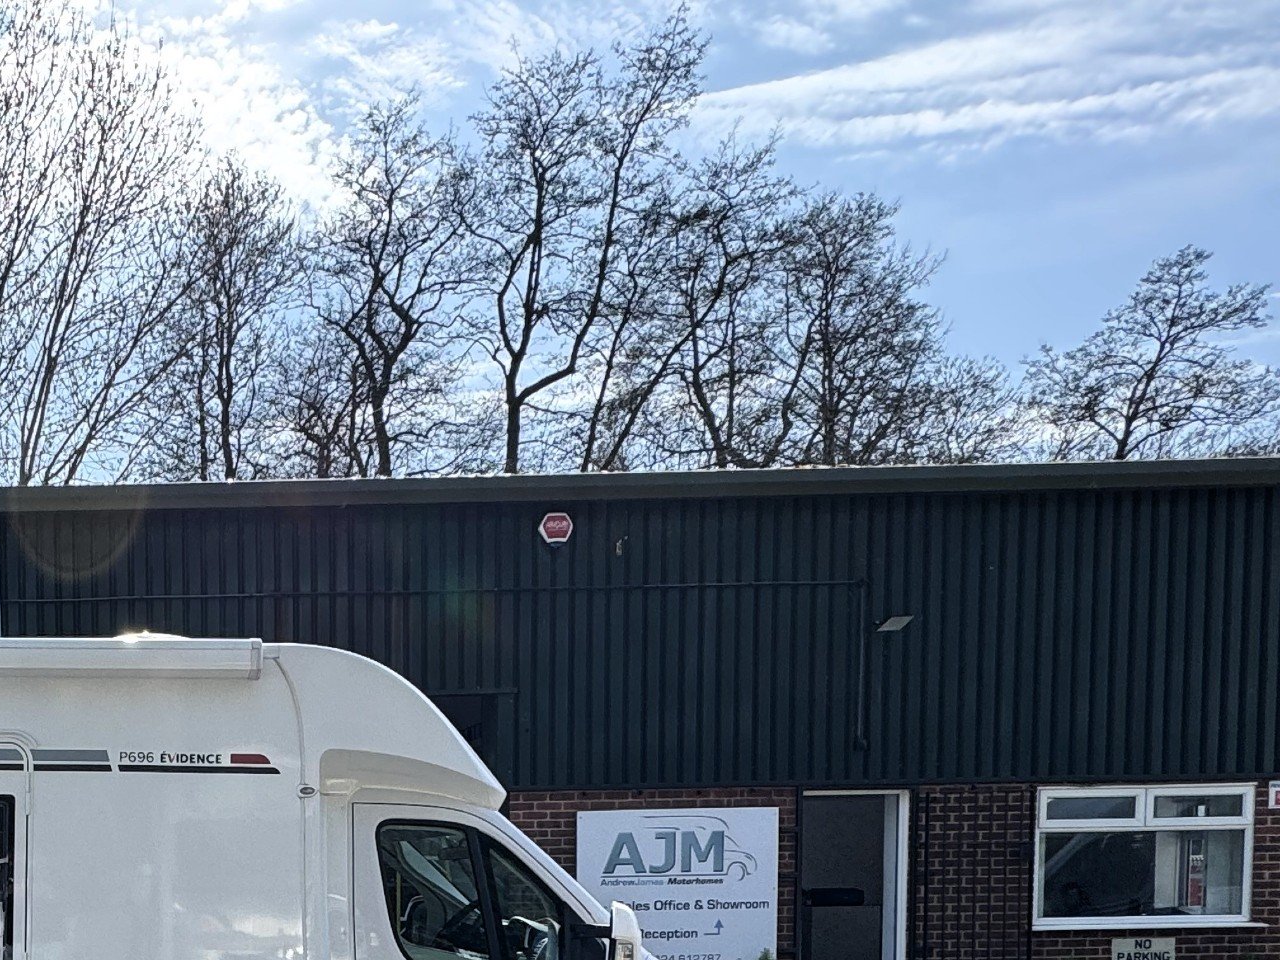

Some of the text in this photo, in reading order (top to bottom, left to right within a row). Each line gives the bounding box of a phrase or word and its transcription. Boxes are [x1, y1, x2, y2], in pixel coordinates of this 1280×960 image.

[119, 751, 222, 764] P696 ÉVIDENCE
[602, 830, 724, 874] AJM
[667, 877, 724, 886] Motorhomes
[654, 899, 690, 911] Office
[694, 899, 703, 910] &
[707, 898, 770, 910] Showroom
[1135, 939, 1152, 949] NO
